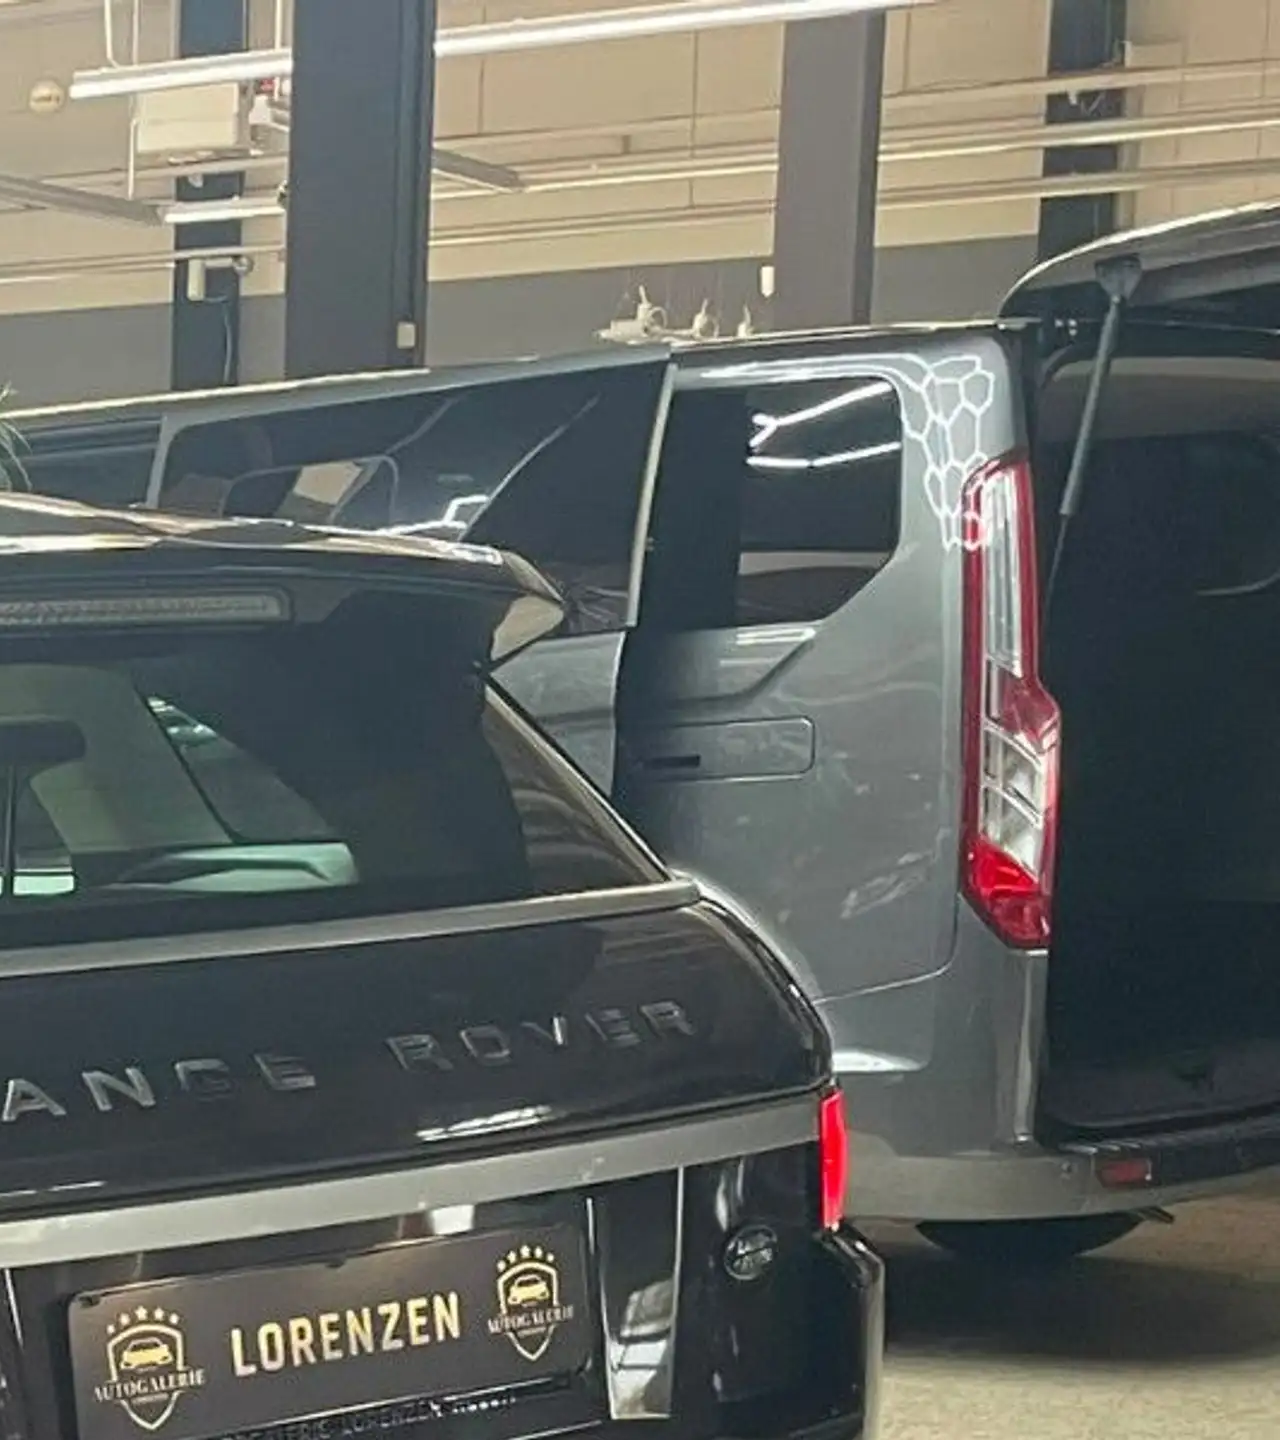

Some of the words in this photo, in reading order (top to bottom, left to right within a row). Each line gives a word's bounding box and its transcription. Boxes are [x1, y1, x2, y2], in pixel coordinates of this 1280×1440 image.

[385, 1000, 696, 1071] ROVER
[230, 1291, 461, 1378] LORENZEN
[93, 1368, 206, 1403] AUTOGALERIE
